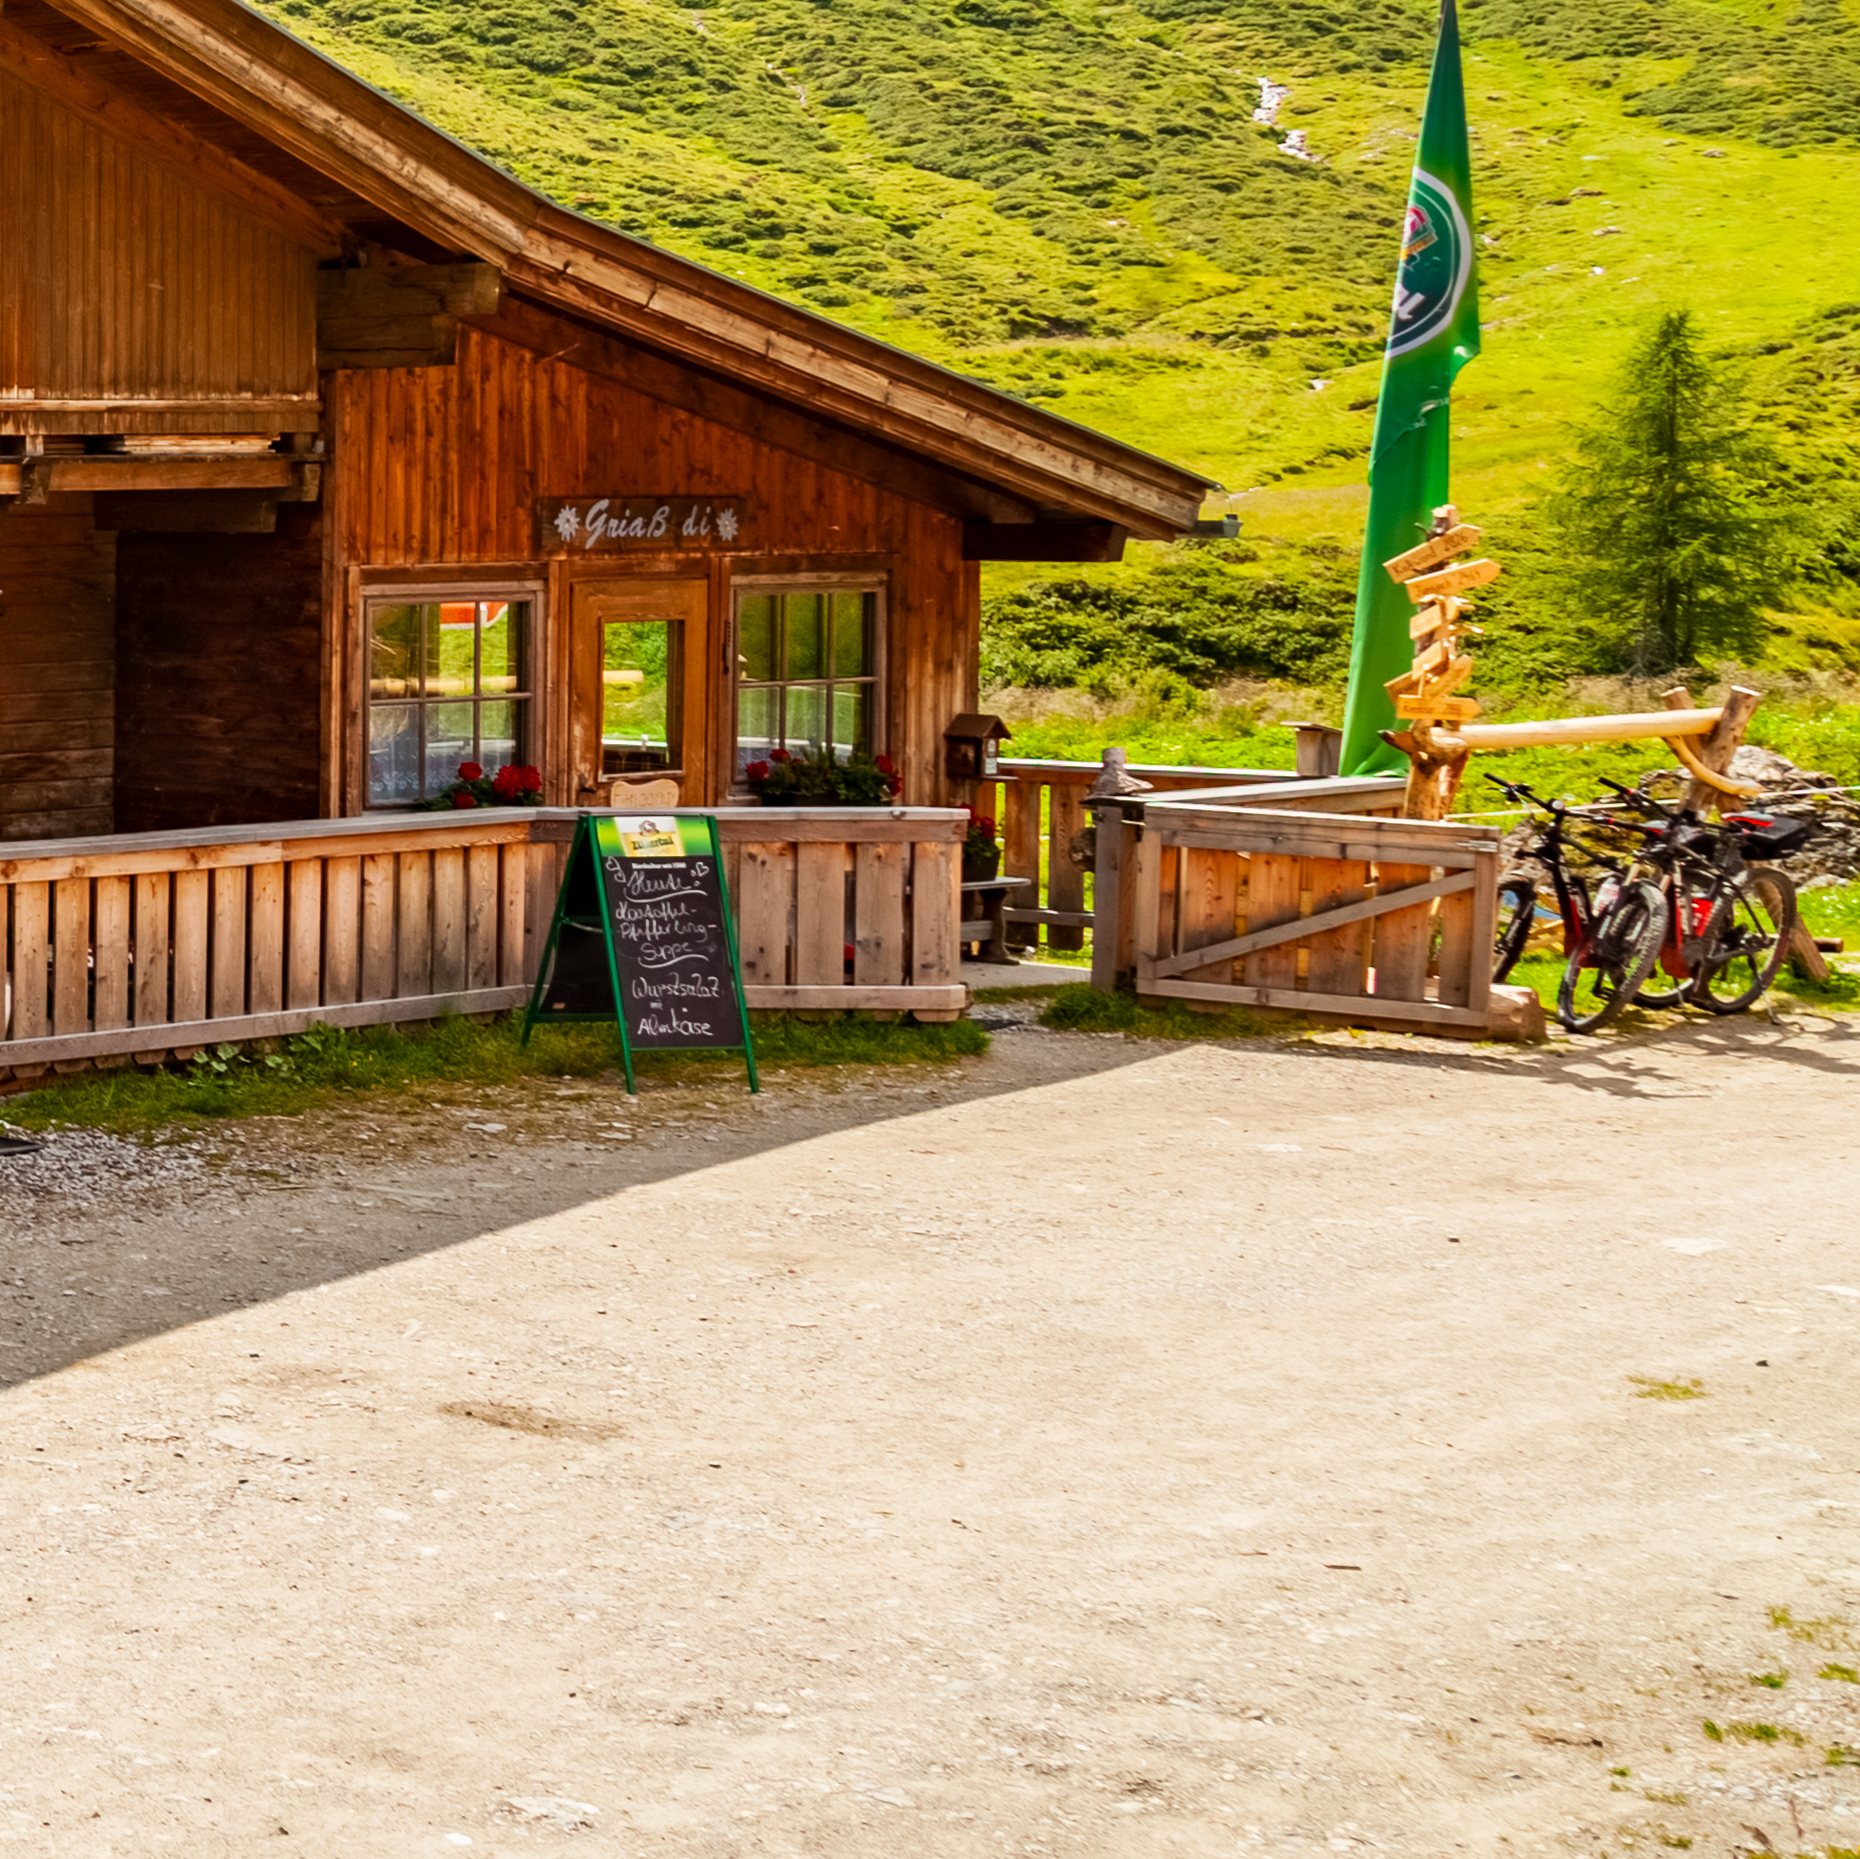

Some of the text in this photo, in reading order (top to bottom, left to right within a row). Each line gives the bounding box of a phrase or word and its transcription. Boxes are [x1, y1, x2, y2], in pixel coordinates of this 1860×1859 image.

[682, 504, 711, 537] di
[631, 836, 674, 851] Ziertal
[640, 943, 693, 960] Suppe
[632, 972, 720, 999] Wurstsalat
